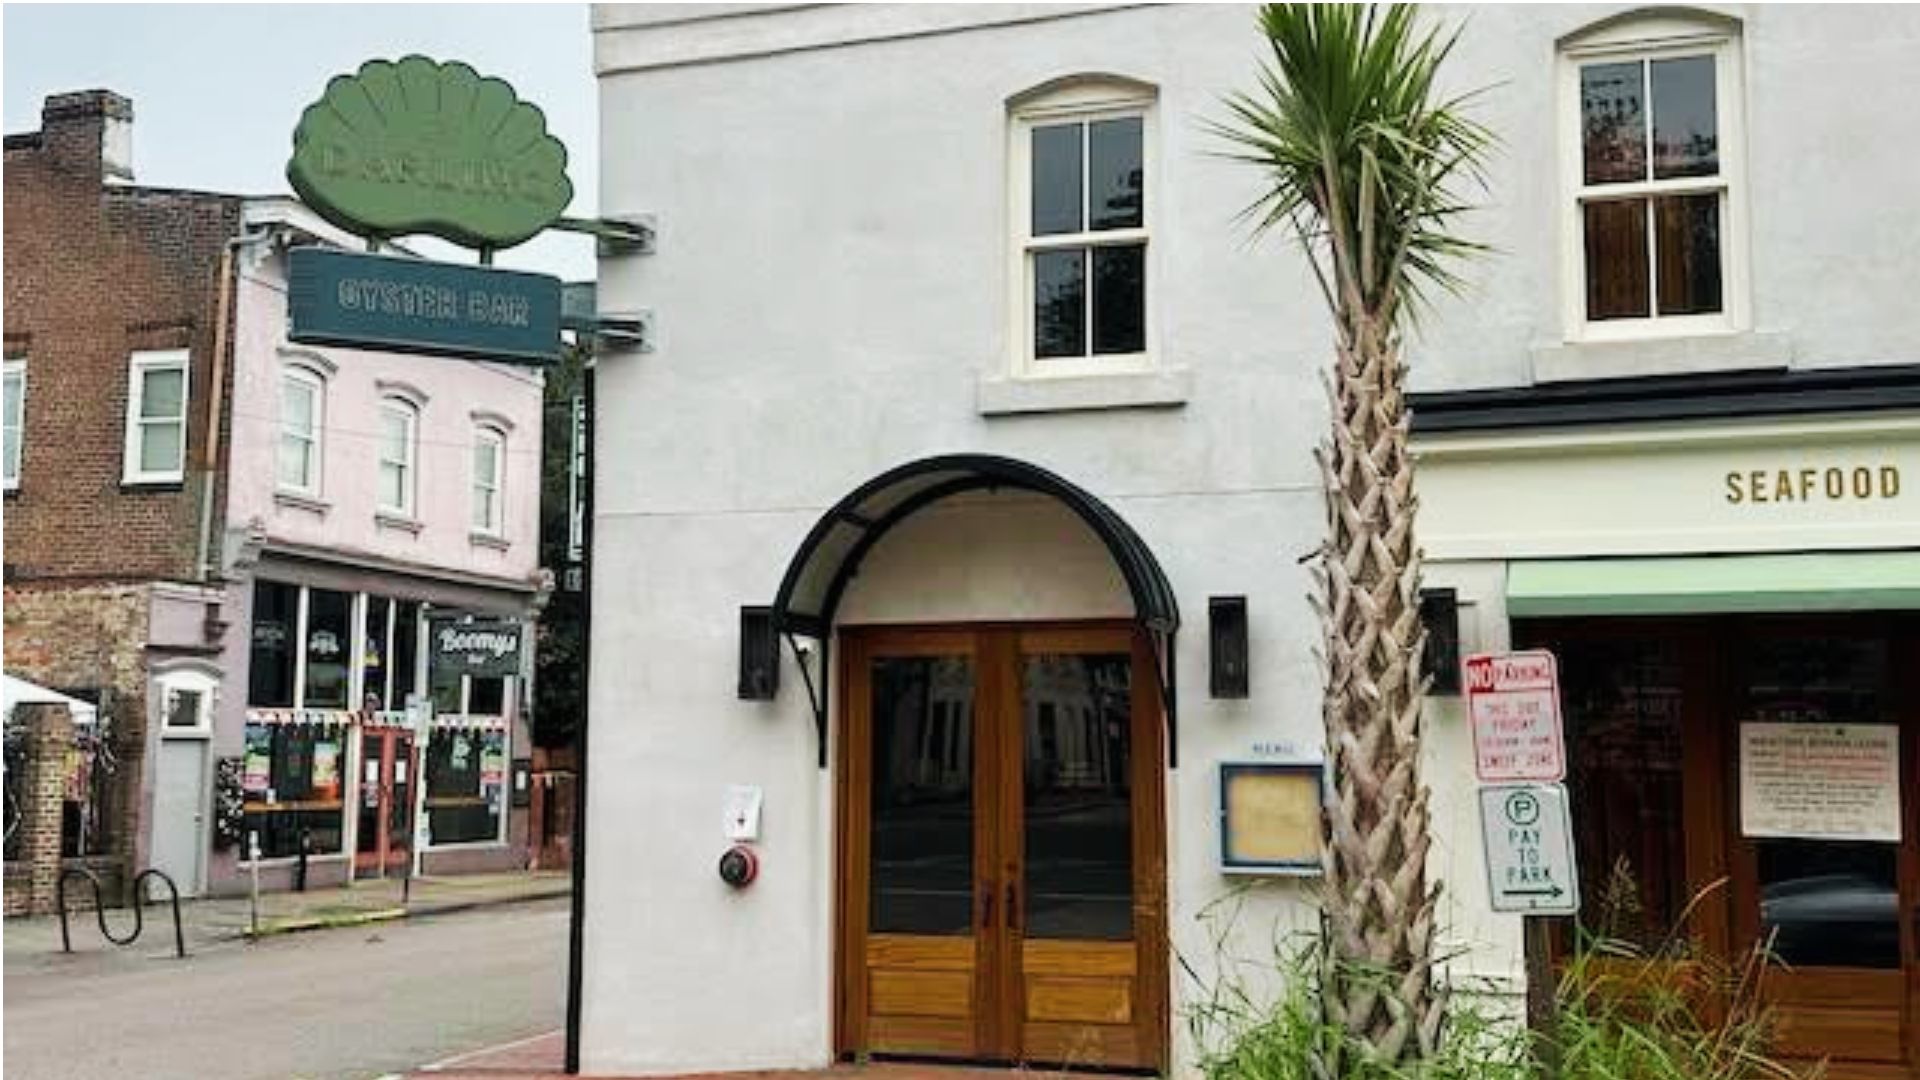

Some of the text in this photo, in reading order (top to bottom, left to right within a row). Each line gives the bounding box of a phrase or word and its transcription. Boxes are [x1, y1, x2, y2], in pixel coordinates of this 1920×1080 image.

[338, 278, 530, 328] OYSTER BAR
[1725, 466, 1900, 504] SEAFOOD
[1469, 663, 1493, 688] NO
[1514, 799, 1531, 819] P
[1508, 829, 1540, 845] PAY
[1517, 848, 1539, 865] TO
[1506, 866, 1551, 885] PARK
